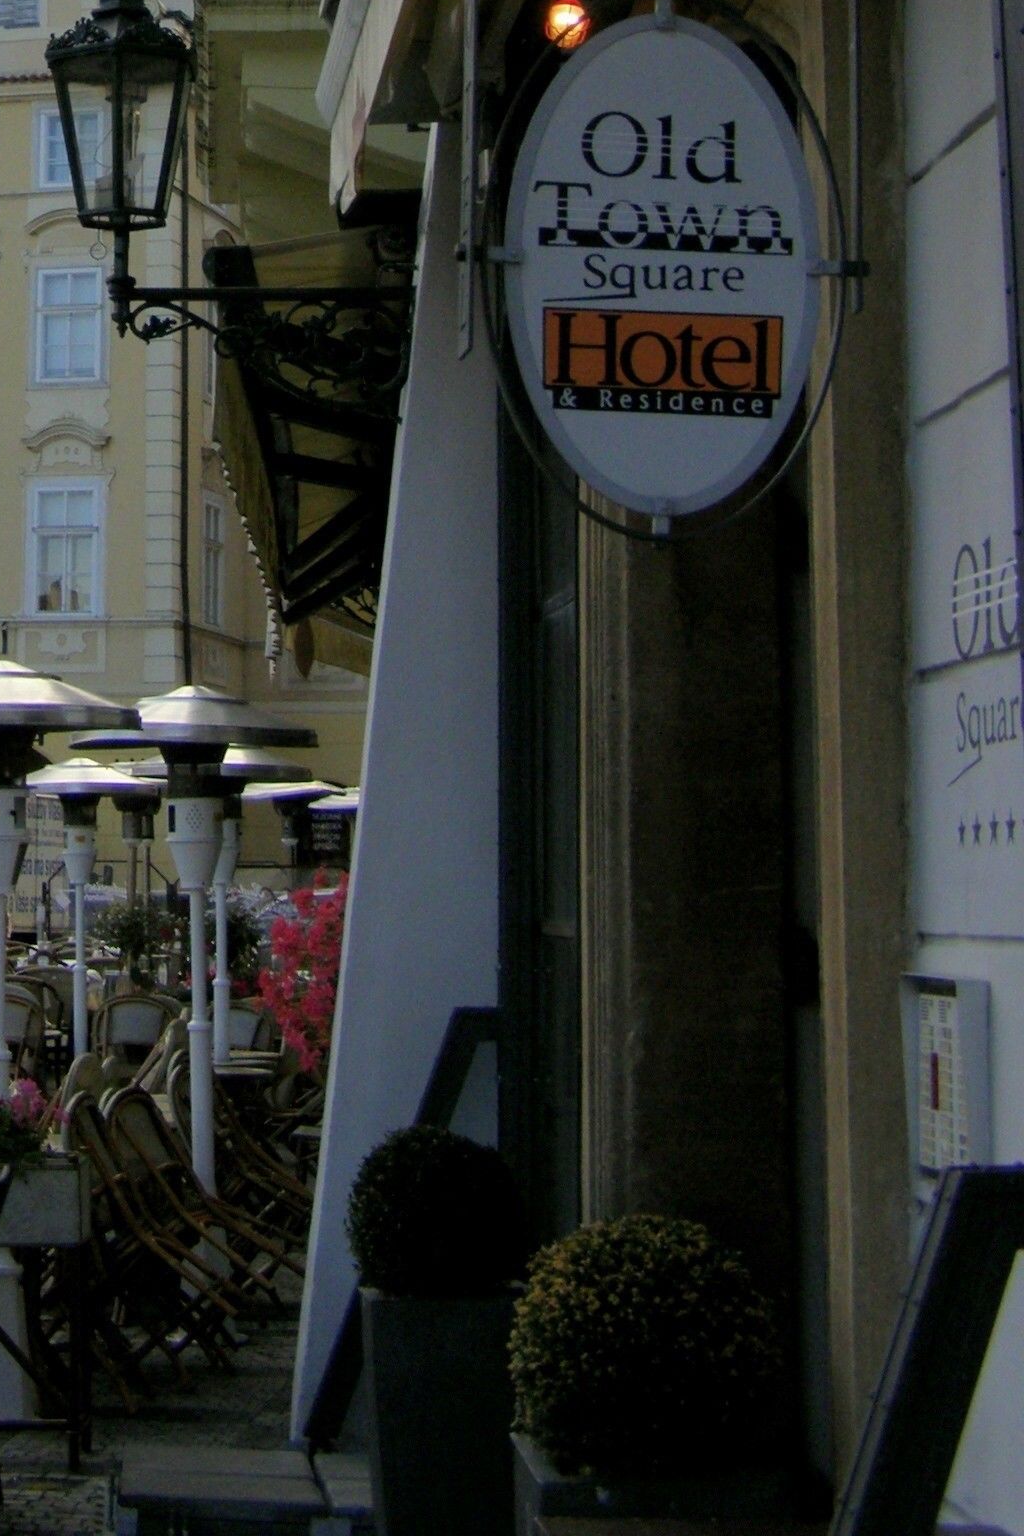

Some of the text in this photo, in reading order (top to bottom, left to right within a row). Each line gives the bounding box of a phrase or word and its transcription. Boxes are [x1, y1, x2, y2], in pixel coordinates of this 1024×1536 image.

[581, 111, 740, 183] Old
[533, 180, 788, 254] Town
[583, 253, 745, 298] Square
[550, 312, 772, 392] Hotel
[559, 390, 766, 416] & Residence
[956, 692, 1019, 761] Squar
